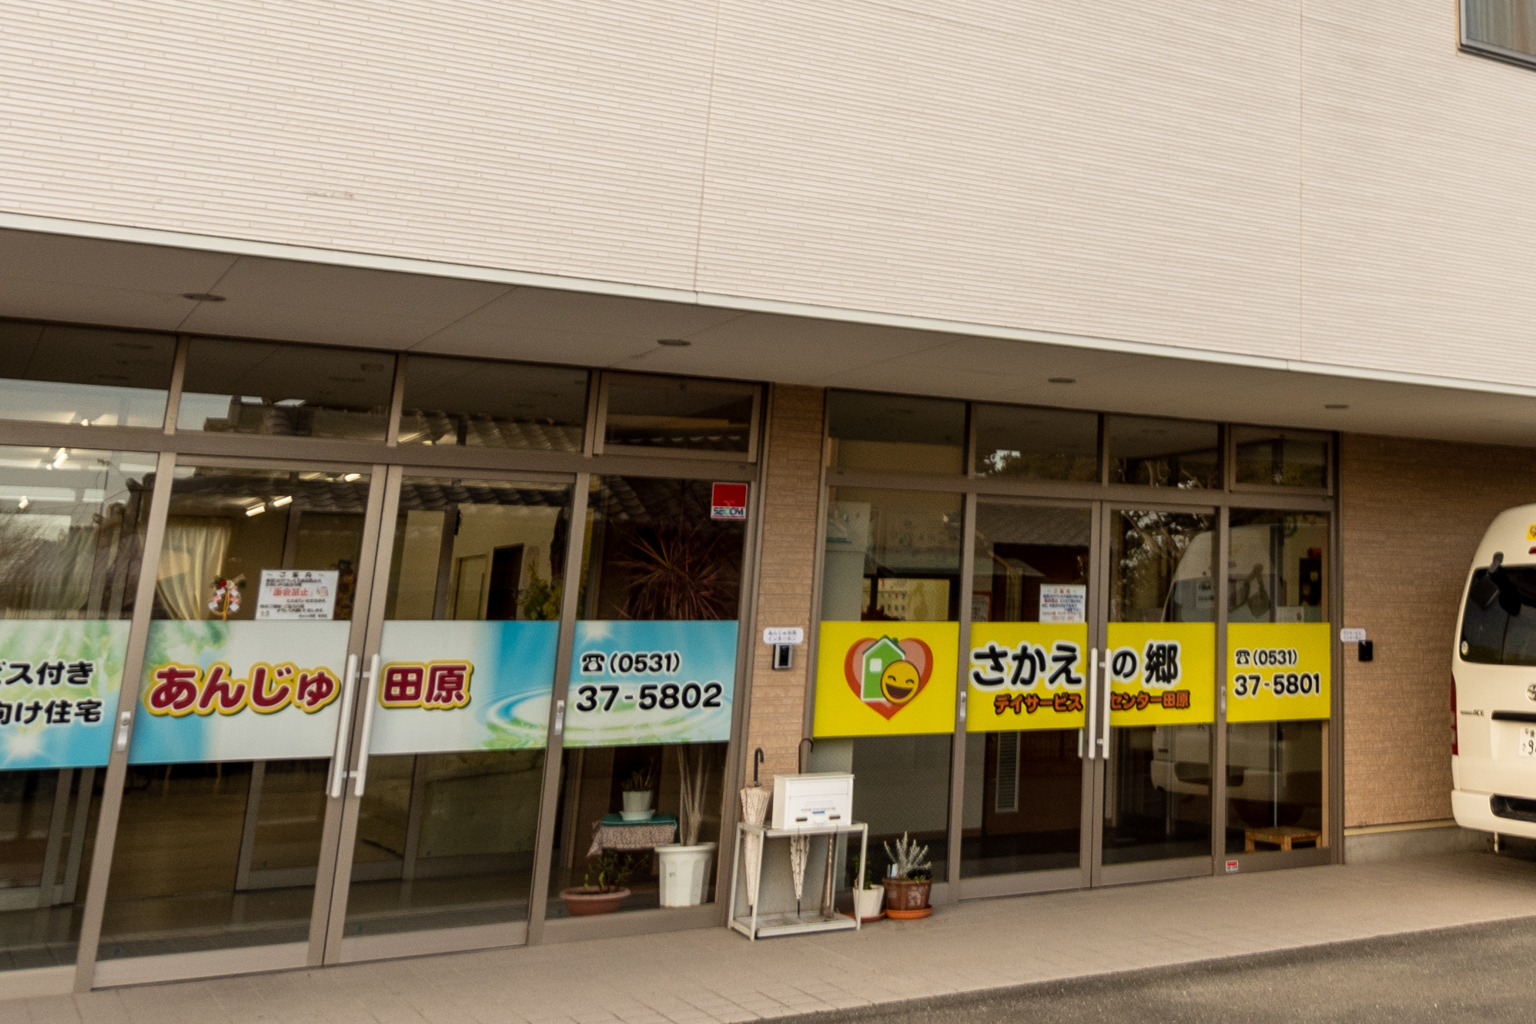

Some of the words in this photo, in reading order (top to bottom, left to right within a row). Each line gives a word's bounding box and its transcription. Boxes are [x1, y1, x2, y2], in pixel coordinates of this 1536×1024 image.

[713, 507, 744, 515] SECOM
[610, 652, 680, 674] (0531)
[1253, 649, 1298, 666] (0531)
[0, 661, 94, 685] ス付き
[1234, 672, 1320, 696] 37-5801
[149, 665, 336, 710] あんじゅ
[382, 662, 470, 705] 田原
[576, 682, 722, 712] 37-5802
